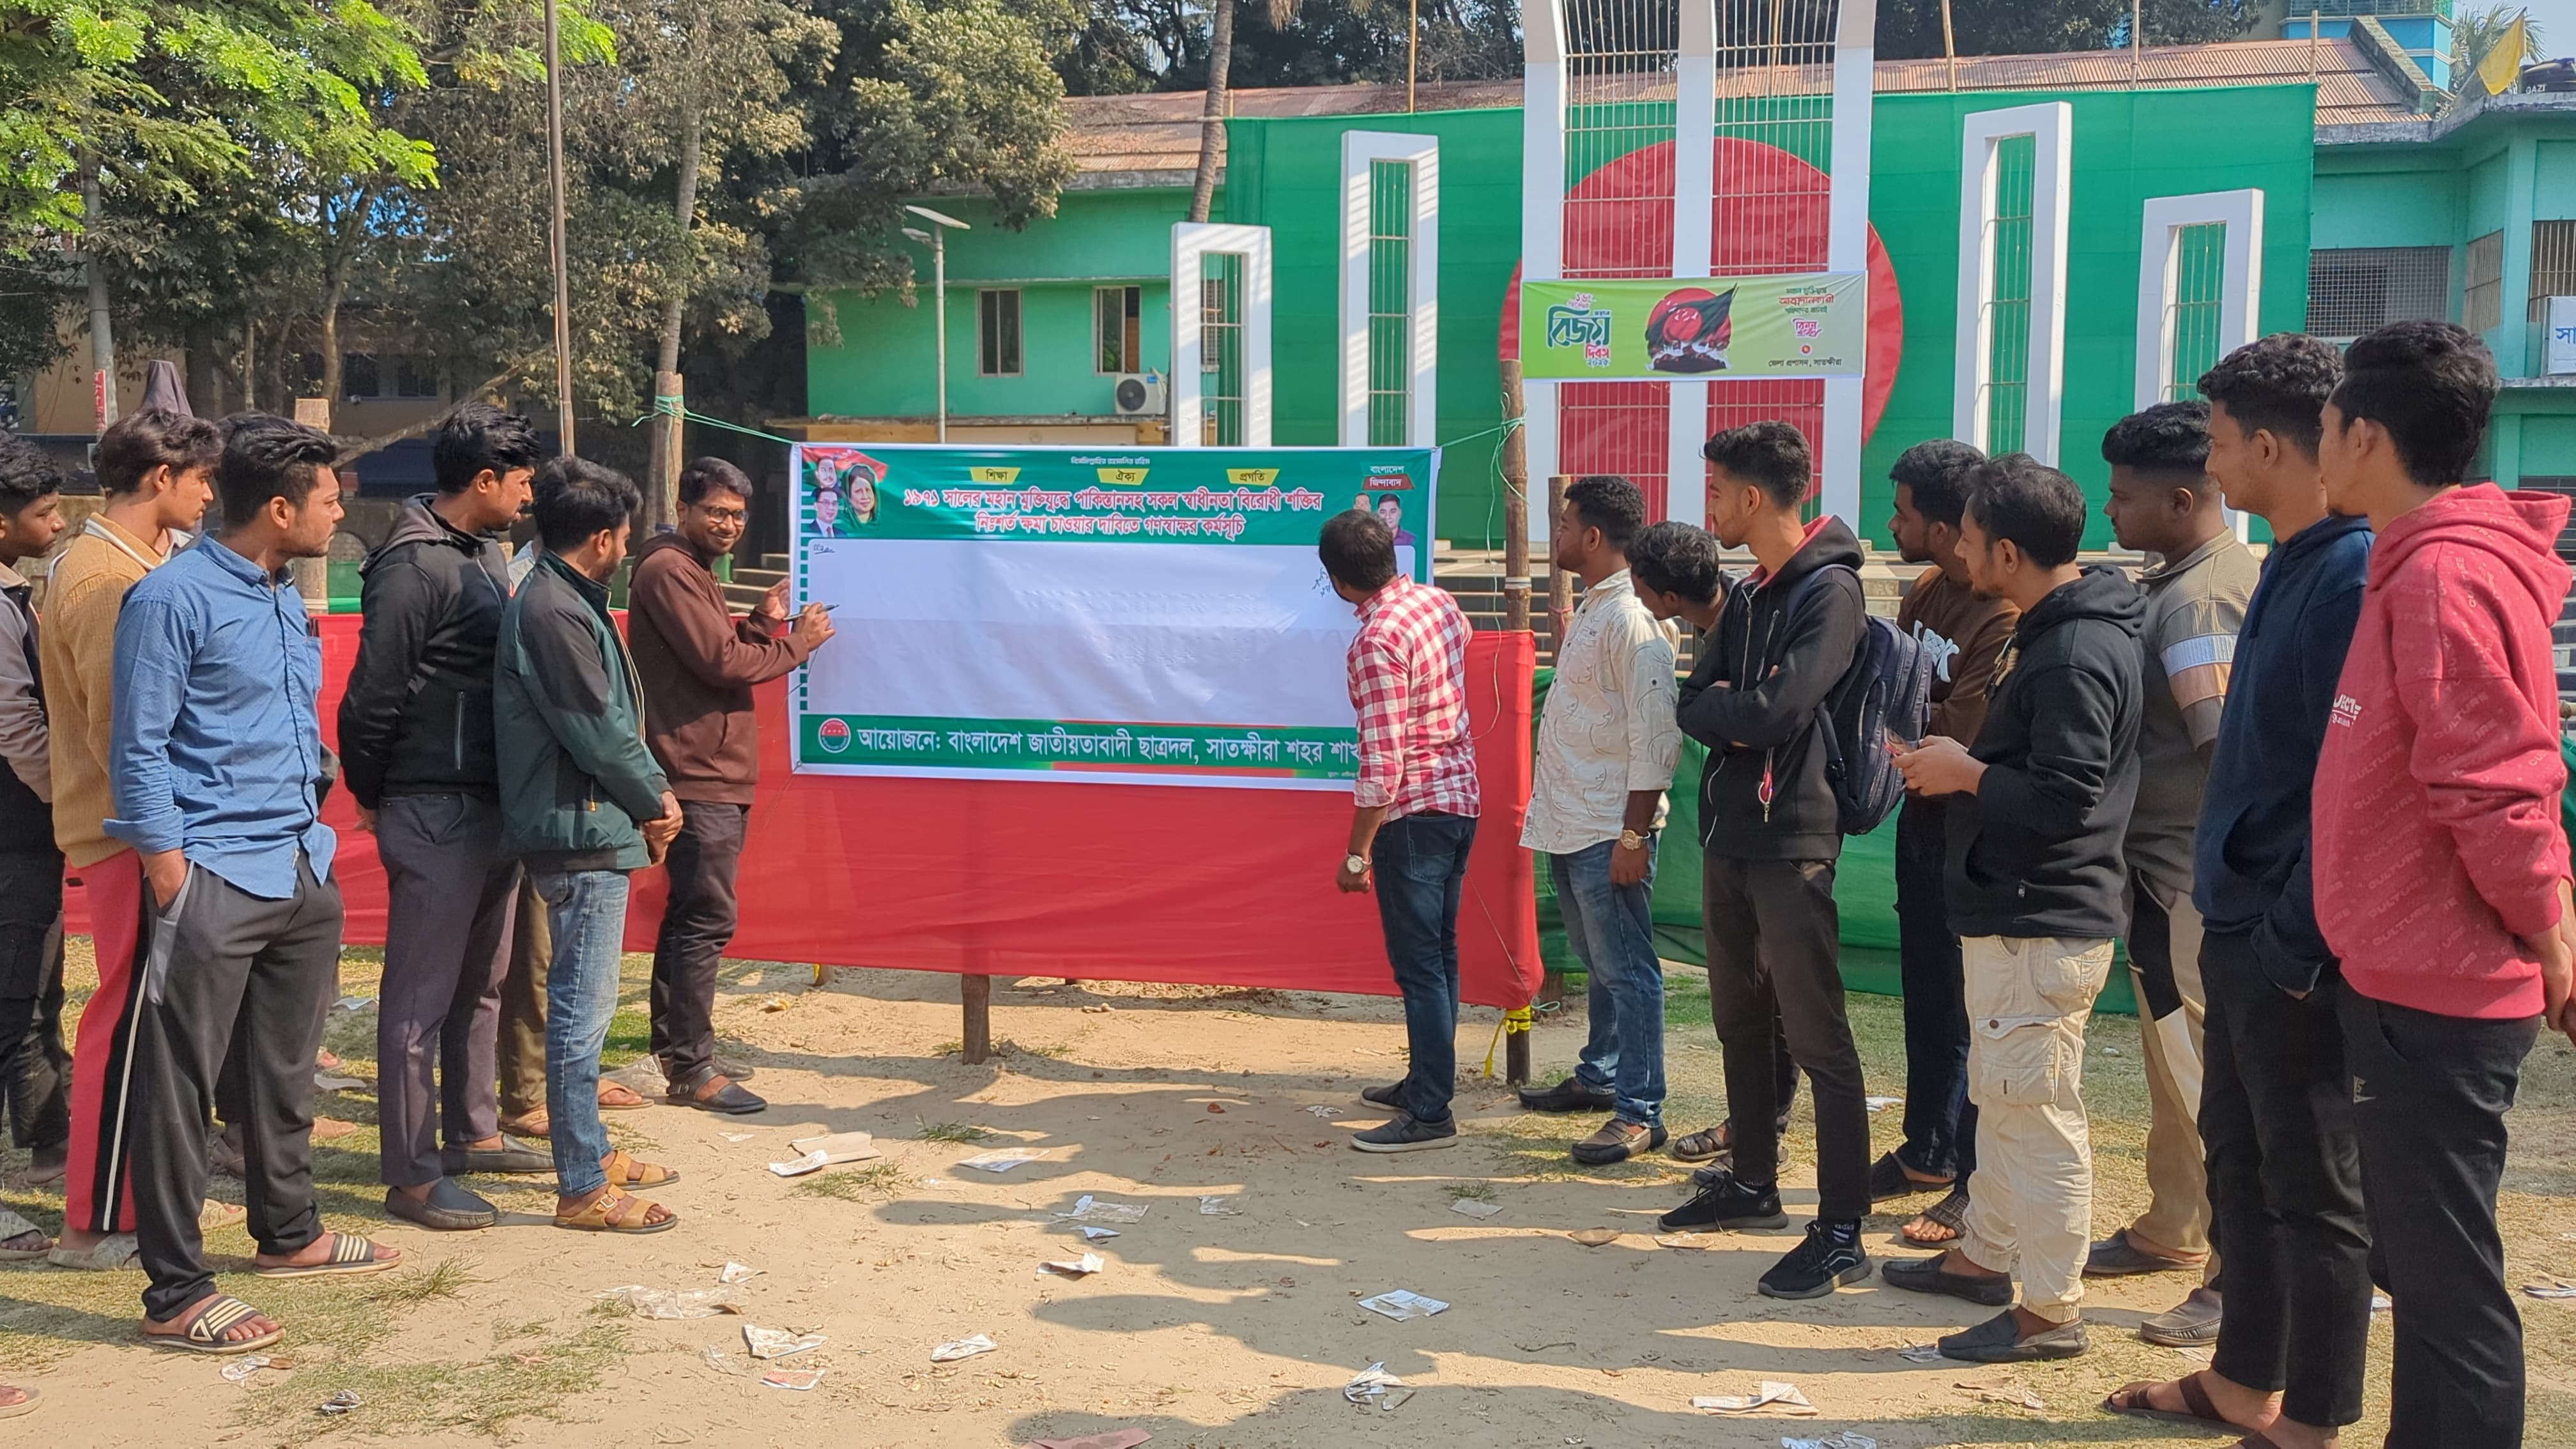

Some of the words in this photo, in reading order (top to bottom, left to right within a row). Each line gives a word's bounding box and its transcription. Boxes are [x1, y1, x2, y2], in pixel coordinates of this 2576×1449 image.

[2526, 84, 2547, 94] GAZI
[1547, 305, 1611, 348] বিজয়
[1585, 344, 1610, 358] দিবস
[1813, 356, 1842, 367] সাতক্ষীরা
[986, 469, 1008, 480] শিক্ষা
[1369, 465, 1404, 473] বাংলাদেশ
[1116, 470, 1136, 481] ঐক্য
[1239, 470, 1265, 482] প্রগতি
[1369, 477, 1402, 487] জিন্দাবাদ
[904, 489, 939, 507] ১৯৭১
[943, 489, 982, 507] সালের
[985, 491, 1016, 508] মহান
[1020, 486, 1071, 512] মুক্তিযুদ্ধে
[1074, 486, 1146, 512] পাকিস্তানসহ
[1147, 491, 1180, 510] সকল
[1182, 486, 1235, 511] স্বাধীনতা
[1238, 486, 1283, 512] বিরোধী
[1285, 486, 1324, 511] শক্তির
[975, 510, 1020, 533] নিঃশর্ত
[1020, 515, 1048, 533] ক্ষমা
[1050, 515, 1094, 535] চাওয়ার
[1097, 512, 1142, 535] দাবিতে
[1144, 516, 1199, 537] গণস্বাক্ষর
[1201, 512, 1246, 542] কর্মসূচি
[857, 728, 941, 751] আয়োজনে:
[947, 730, 1023, 755] বাংলাদেশ
[1027, 726, 1133, 758] জাতীয়তাবাদী
[1137, 735, 1200, 765] ছাত্রদল,
[1205, 732, 1280, 762] সাতক্ষীরা
[1286, 739, 1324, 766] শহর
